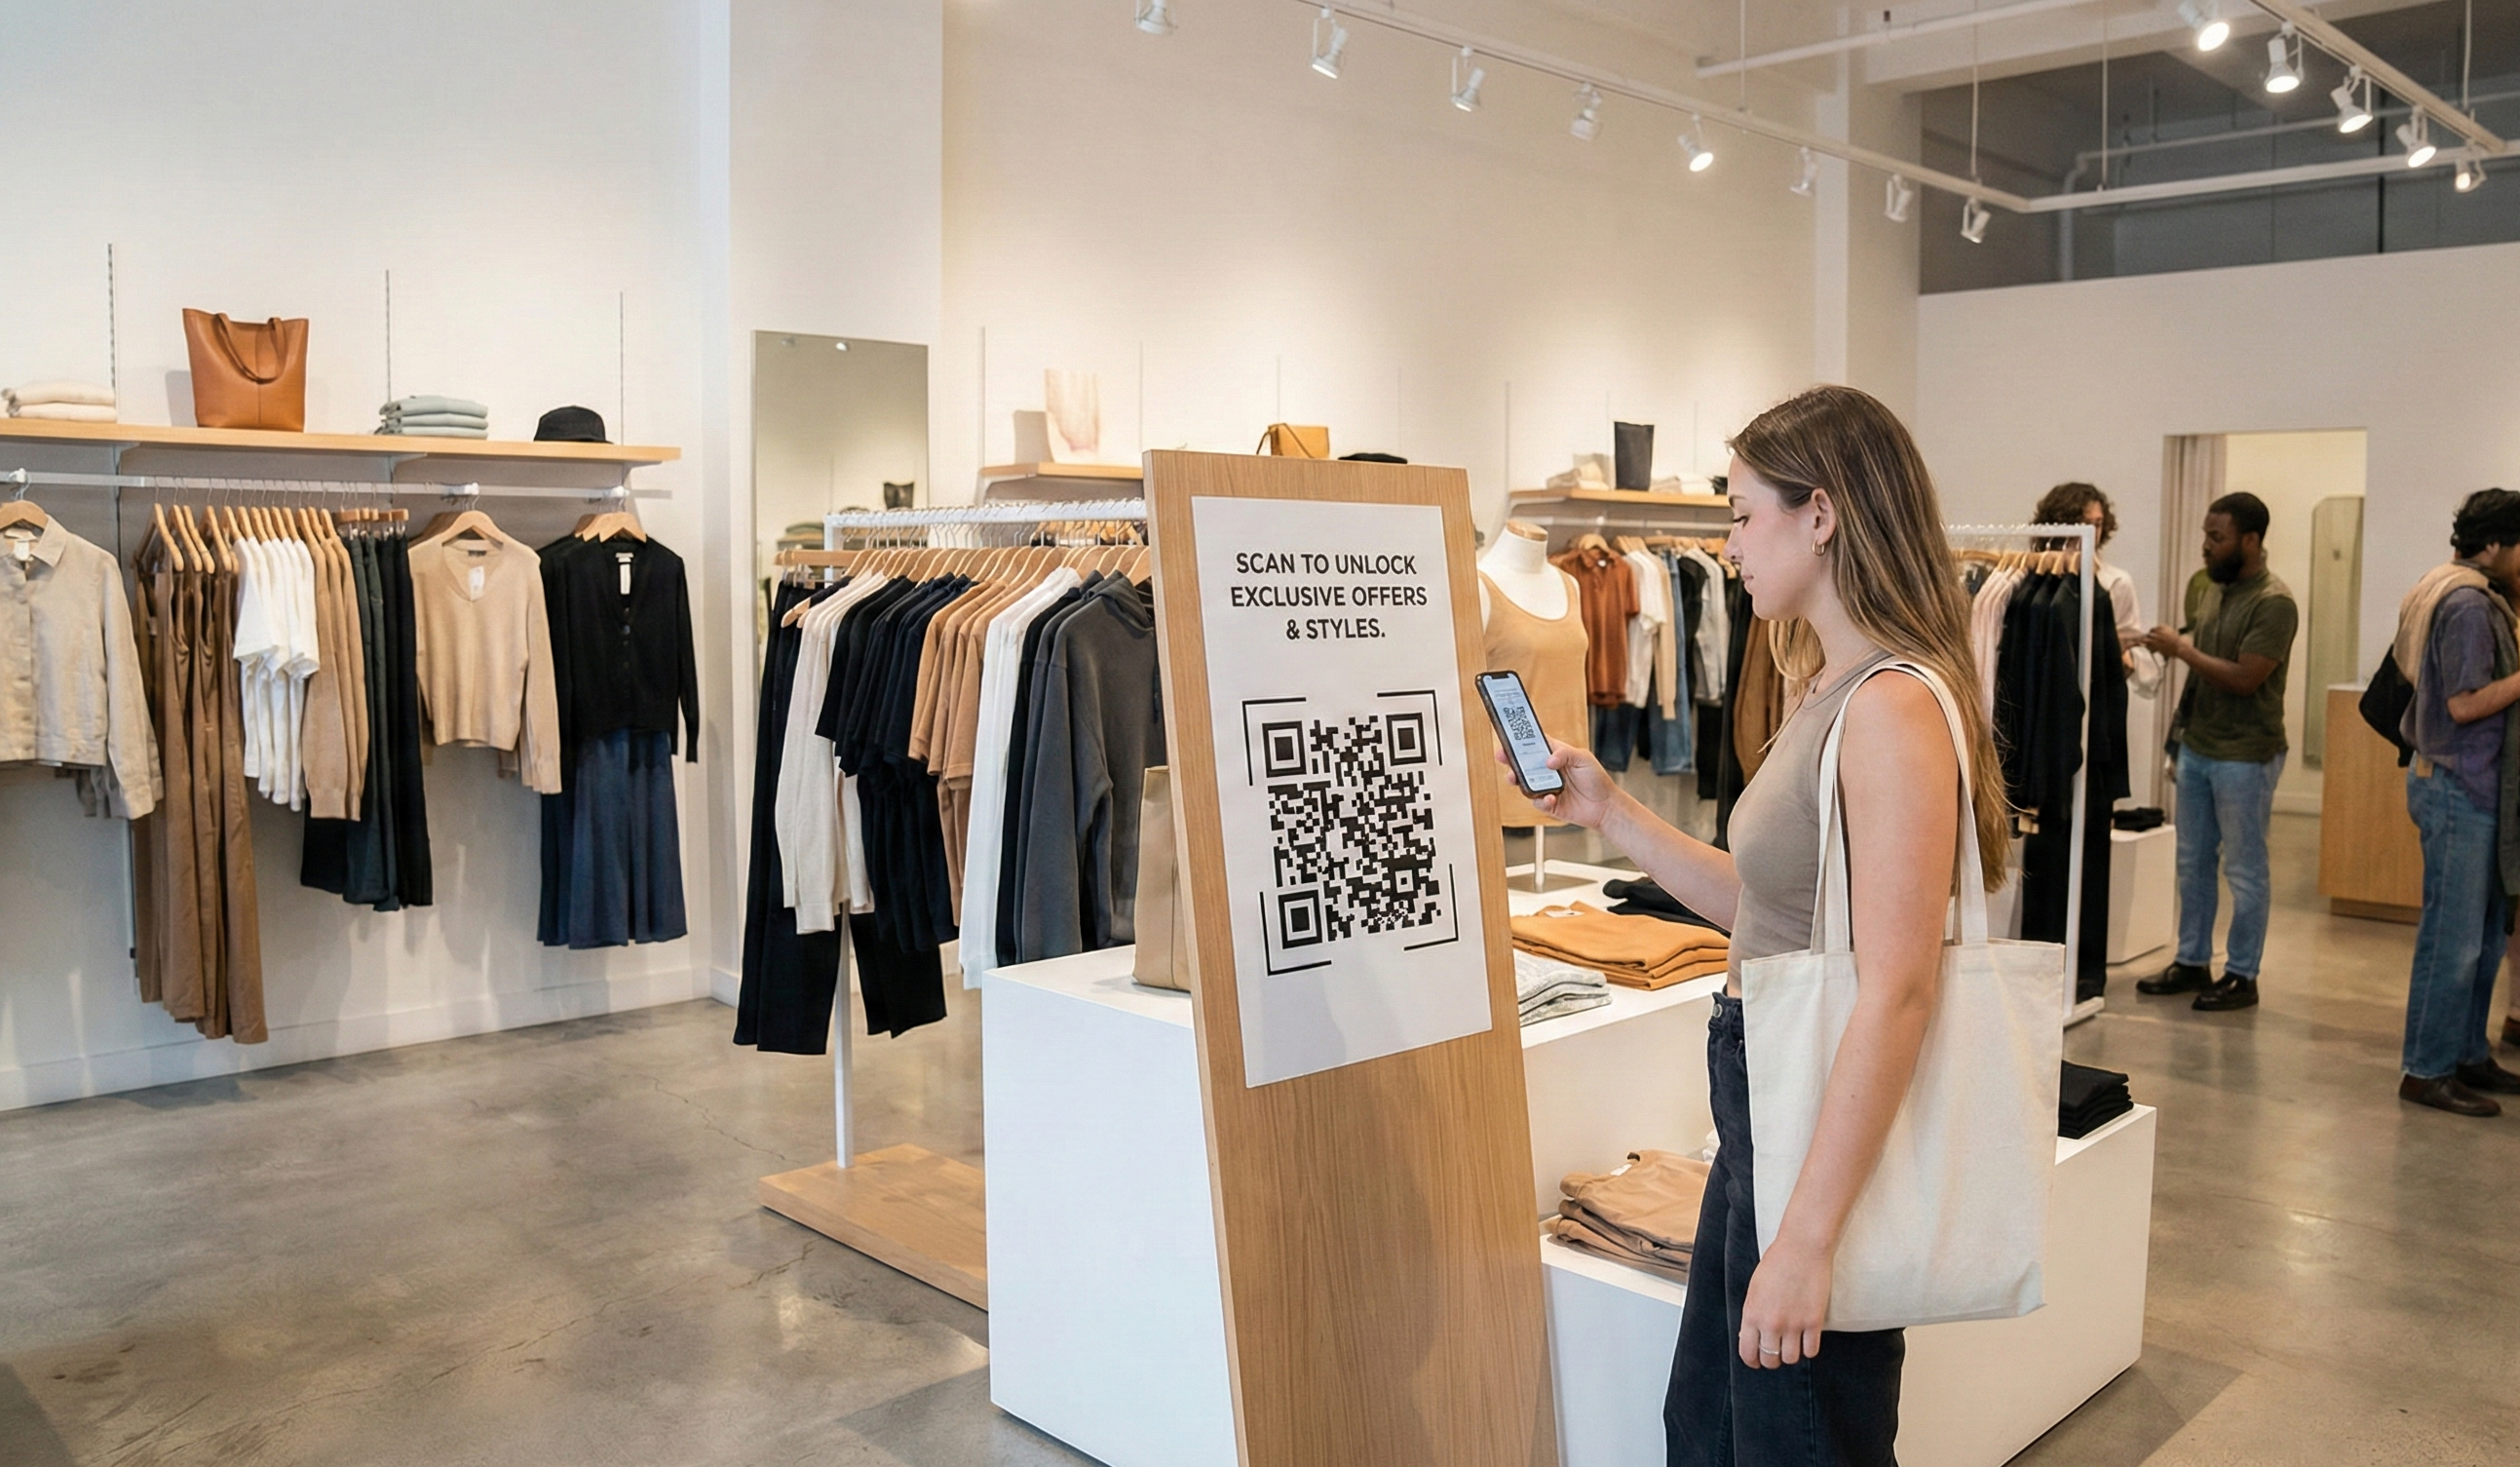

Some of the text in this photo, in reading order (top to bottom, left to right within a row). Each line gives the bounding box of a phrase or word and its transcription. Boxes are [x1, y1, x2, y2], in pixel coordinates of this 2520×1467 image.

[1236, 552, 1418, 575] SCAN TO UNLOCK
[1230, 586, 1428, 607] EXCLUSIVE OFFERS
[1285, 617, 1386, 640] & STYLES.
